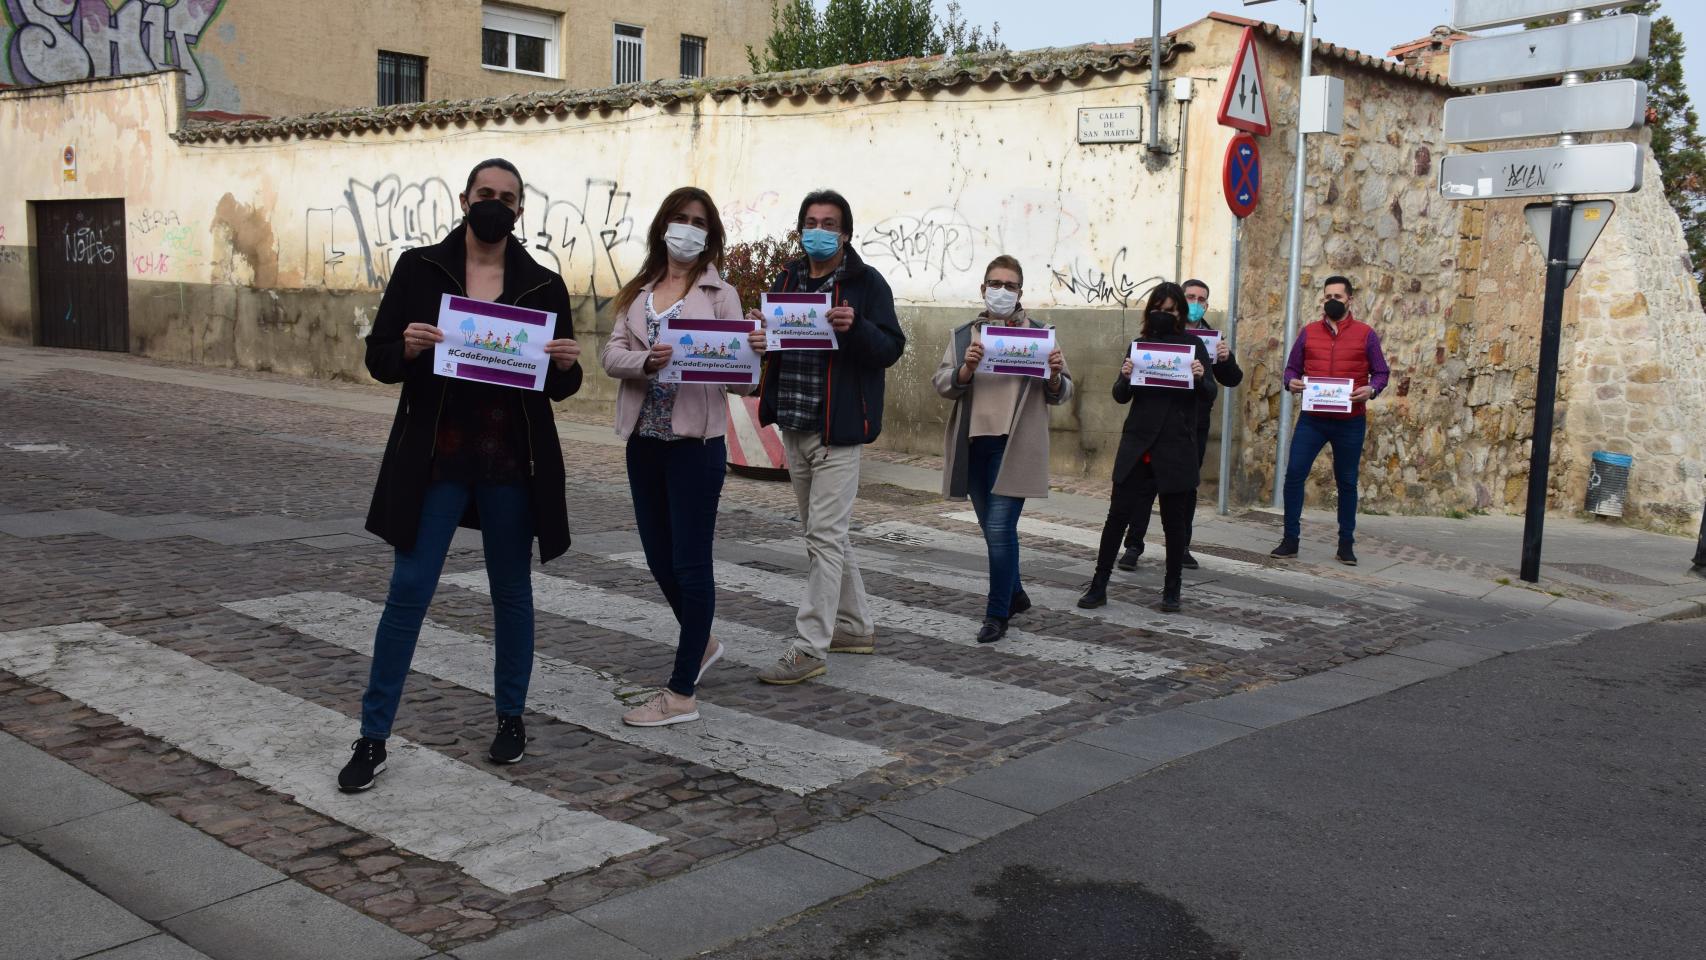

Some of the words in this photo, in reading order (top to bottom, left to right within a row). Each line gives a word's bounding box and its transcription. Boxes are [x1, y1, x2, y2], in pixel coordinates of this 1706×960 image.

[1104, 128, 1135, 137] MARTÍN
[447, 347, 537, 370] #CadaEmpleoCuenta
[672, 359, 752, 370] #CadaEmpleoCuenta
